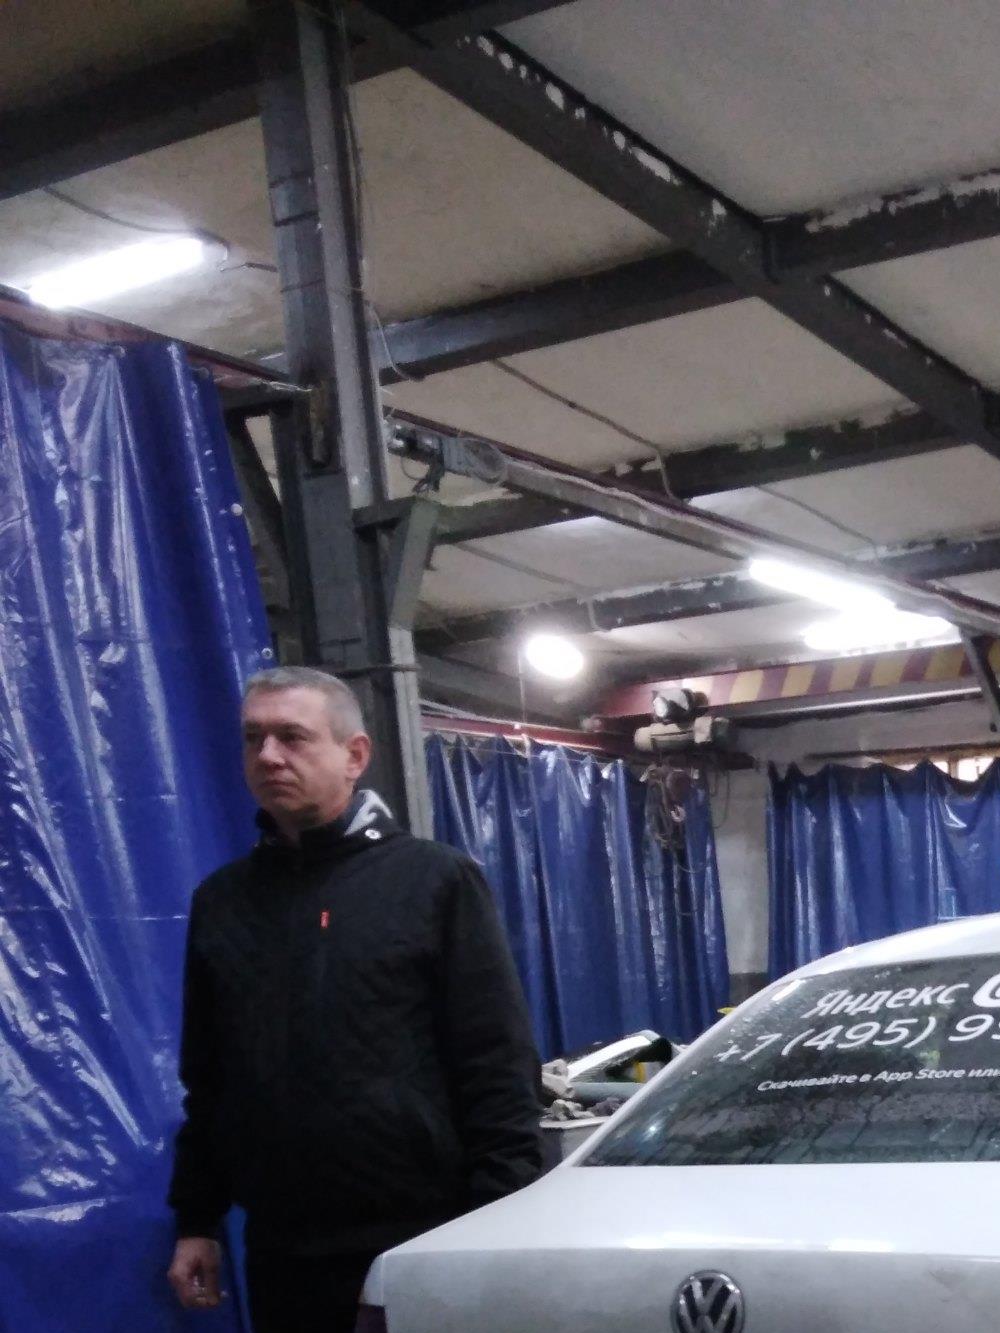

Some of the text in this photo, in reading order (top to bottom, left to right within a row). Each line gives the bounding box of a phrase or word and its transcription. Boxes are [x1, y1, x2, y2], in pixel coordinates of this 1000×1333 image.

[801, 983, 969, 1018] Яндекс
[713, 1033, 783, 1061] +7
[780, 1017, 937, 1056] (495)
[873, 1070, 914, 1083] App
[914, 1067, 966, 1080] Store
